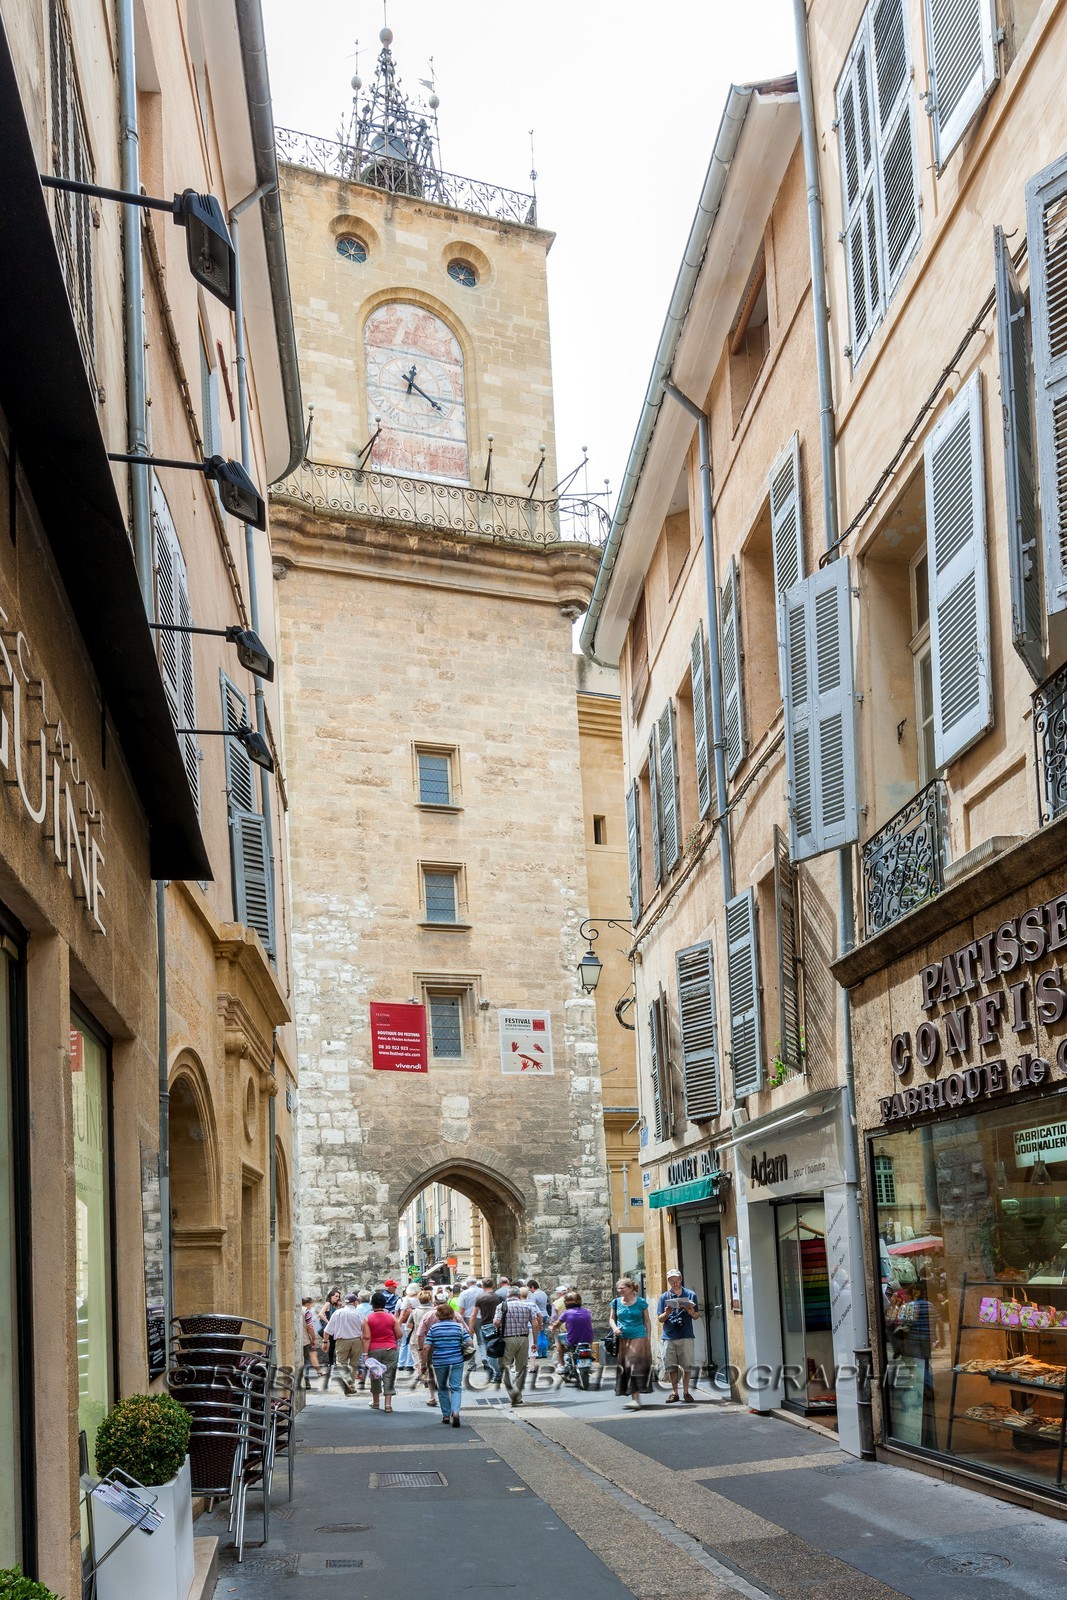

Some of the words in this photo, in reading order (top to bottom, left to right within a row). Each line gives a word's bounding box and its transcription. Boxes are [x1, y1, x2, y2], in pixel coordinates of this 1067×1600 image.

[16, 630, 106, 843] CLAUDE
[0, 637, 107, 937] UINE
[919, 892, 1067, 1010] PATISSE
[505, 1017, 531, 1025] FESTIVAL
[891, 967, 1067, 1077] CONFIS
[878, 1059, 1007, 1124] FABRIQUE
[1012, 1053, 1050, 1088] de
[700, 1149, 720, 1177] BAR
[751, 1151, 789, 1189] Adam
[1015, 1136, 1067, 1155] JOURNALIER
